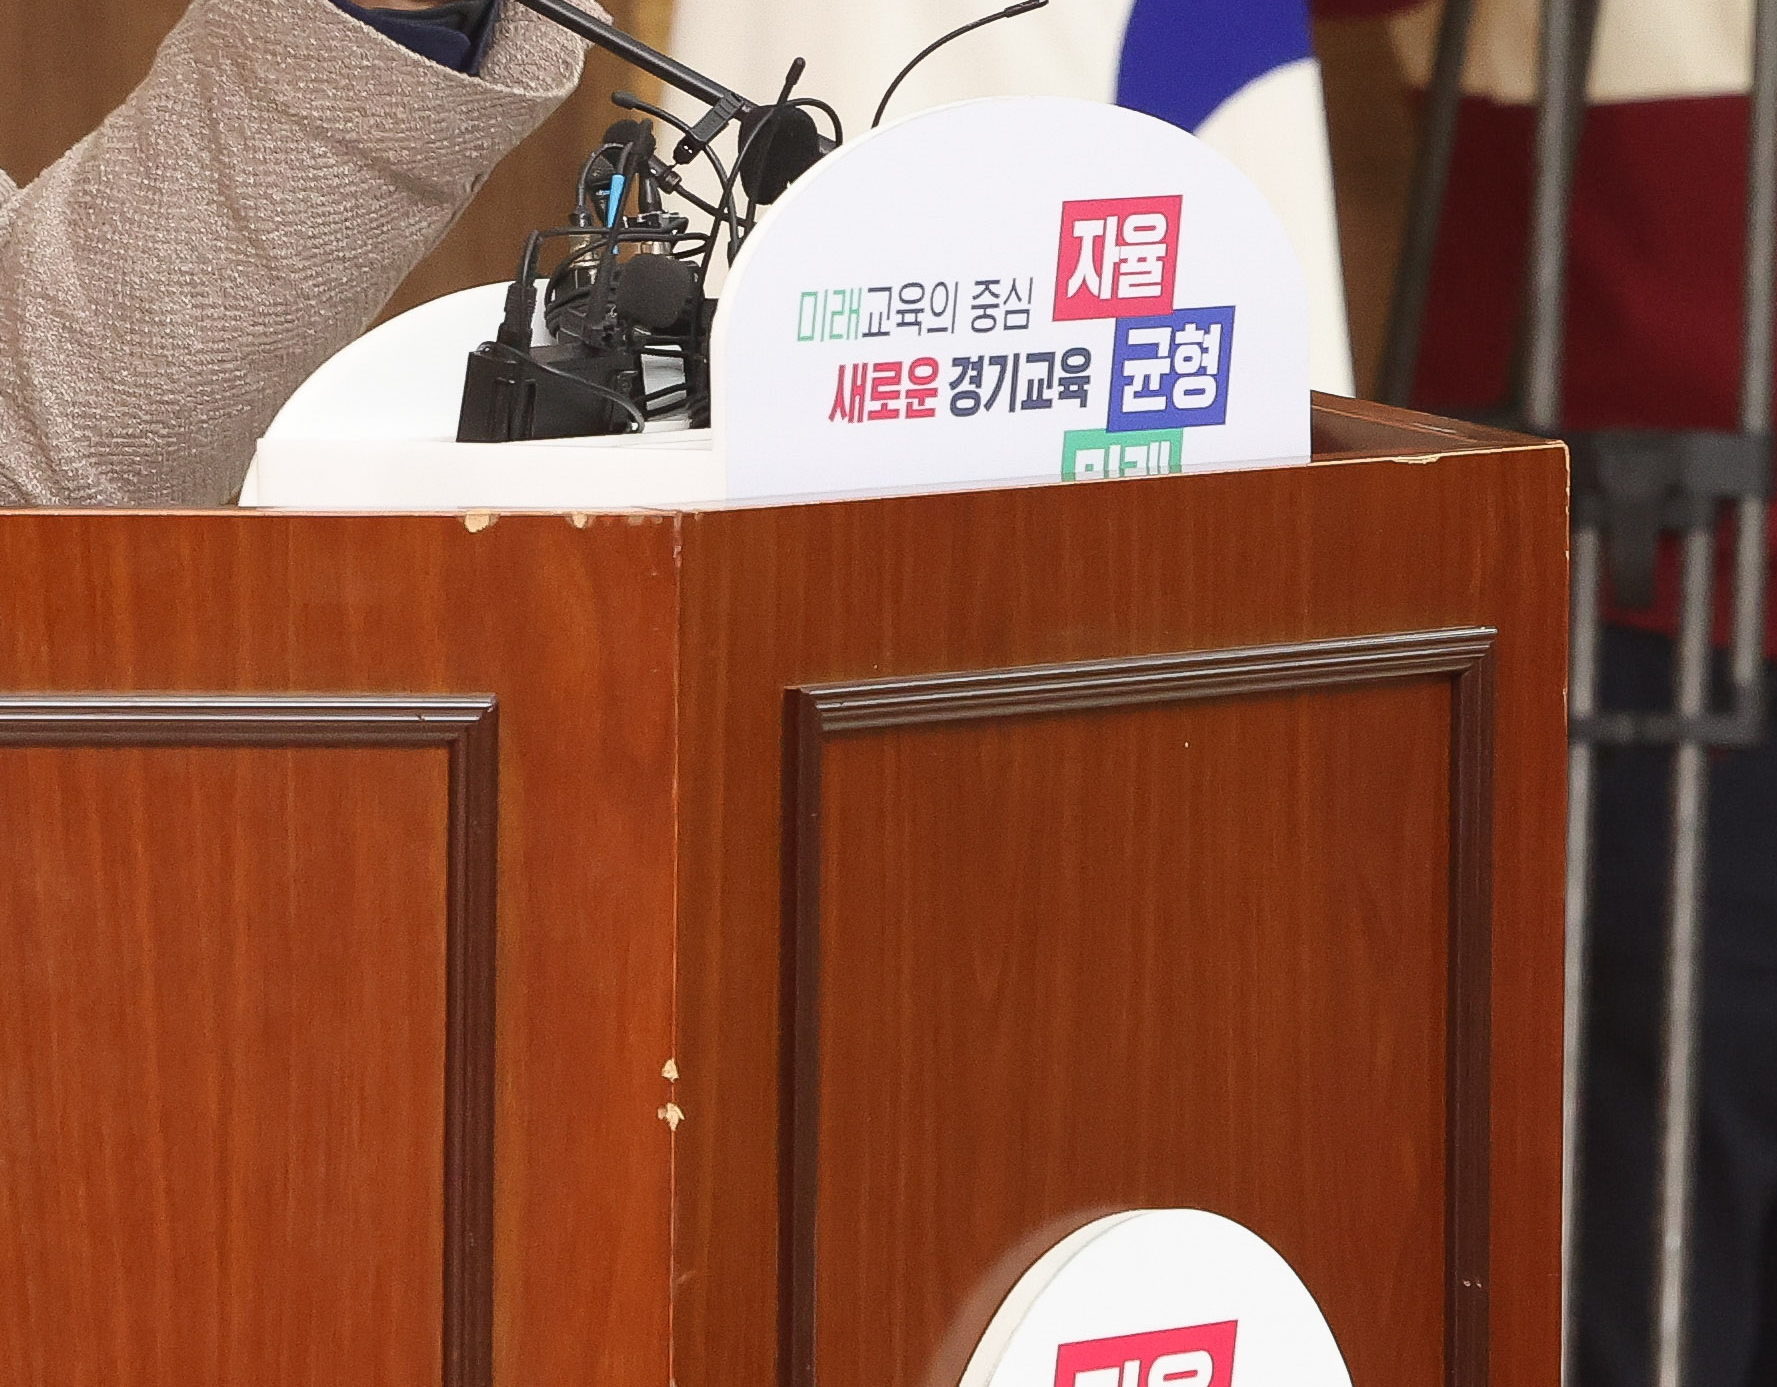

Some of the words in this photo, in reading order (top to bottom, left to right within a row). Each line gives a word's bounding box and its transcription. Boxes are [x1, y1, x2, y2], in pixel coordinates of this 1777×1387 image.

[1066, 212, 1168, 300] 자율
[797, 281, 959, 343] 미래교육의
[970, 277, 1033, 333] 중심
[828, 356, 940, 424] 새로운
[949, 347, 1092, 418] 경기교육
[1121, 322, 1223, 413] 균형
